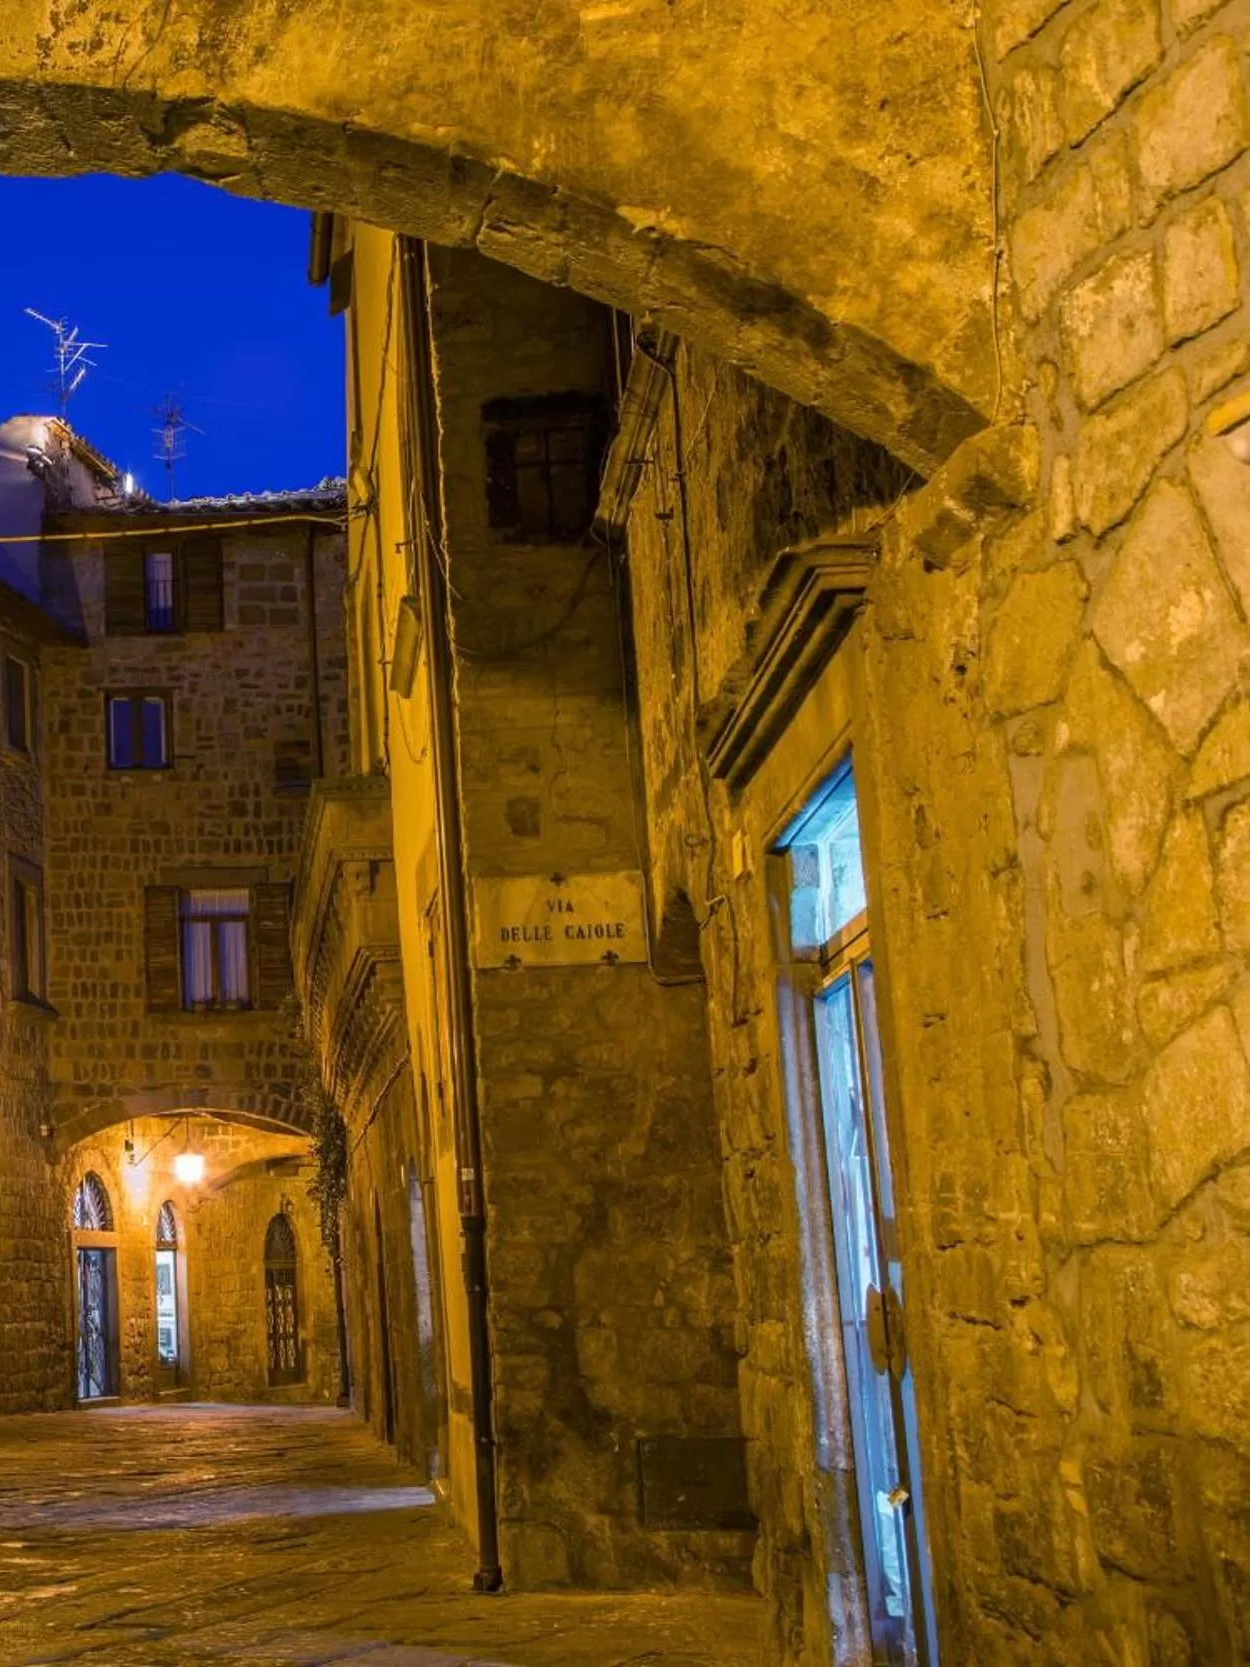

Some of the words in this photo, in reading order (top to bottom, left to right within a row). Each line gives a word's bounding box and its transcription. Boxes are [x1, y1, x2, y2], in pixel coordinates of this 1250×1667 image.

[547, 899, 574, 913] VIA
[500, 926, 553, 942] DELLE
[564, 923, 626, 940] CAIOLE
